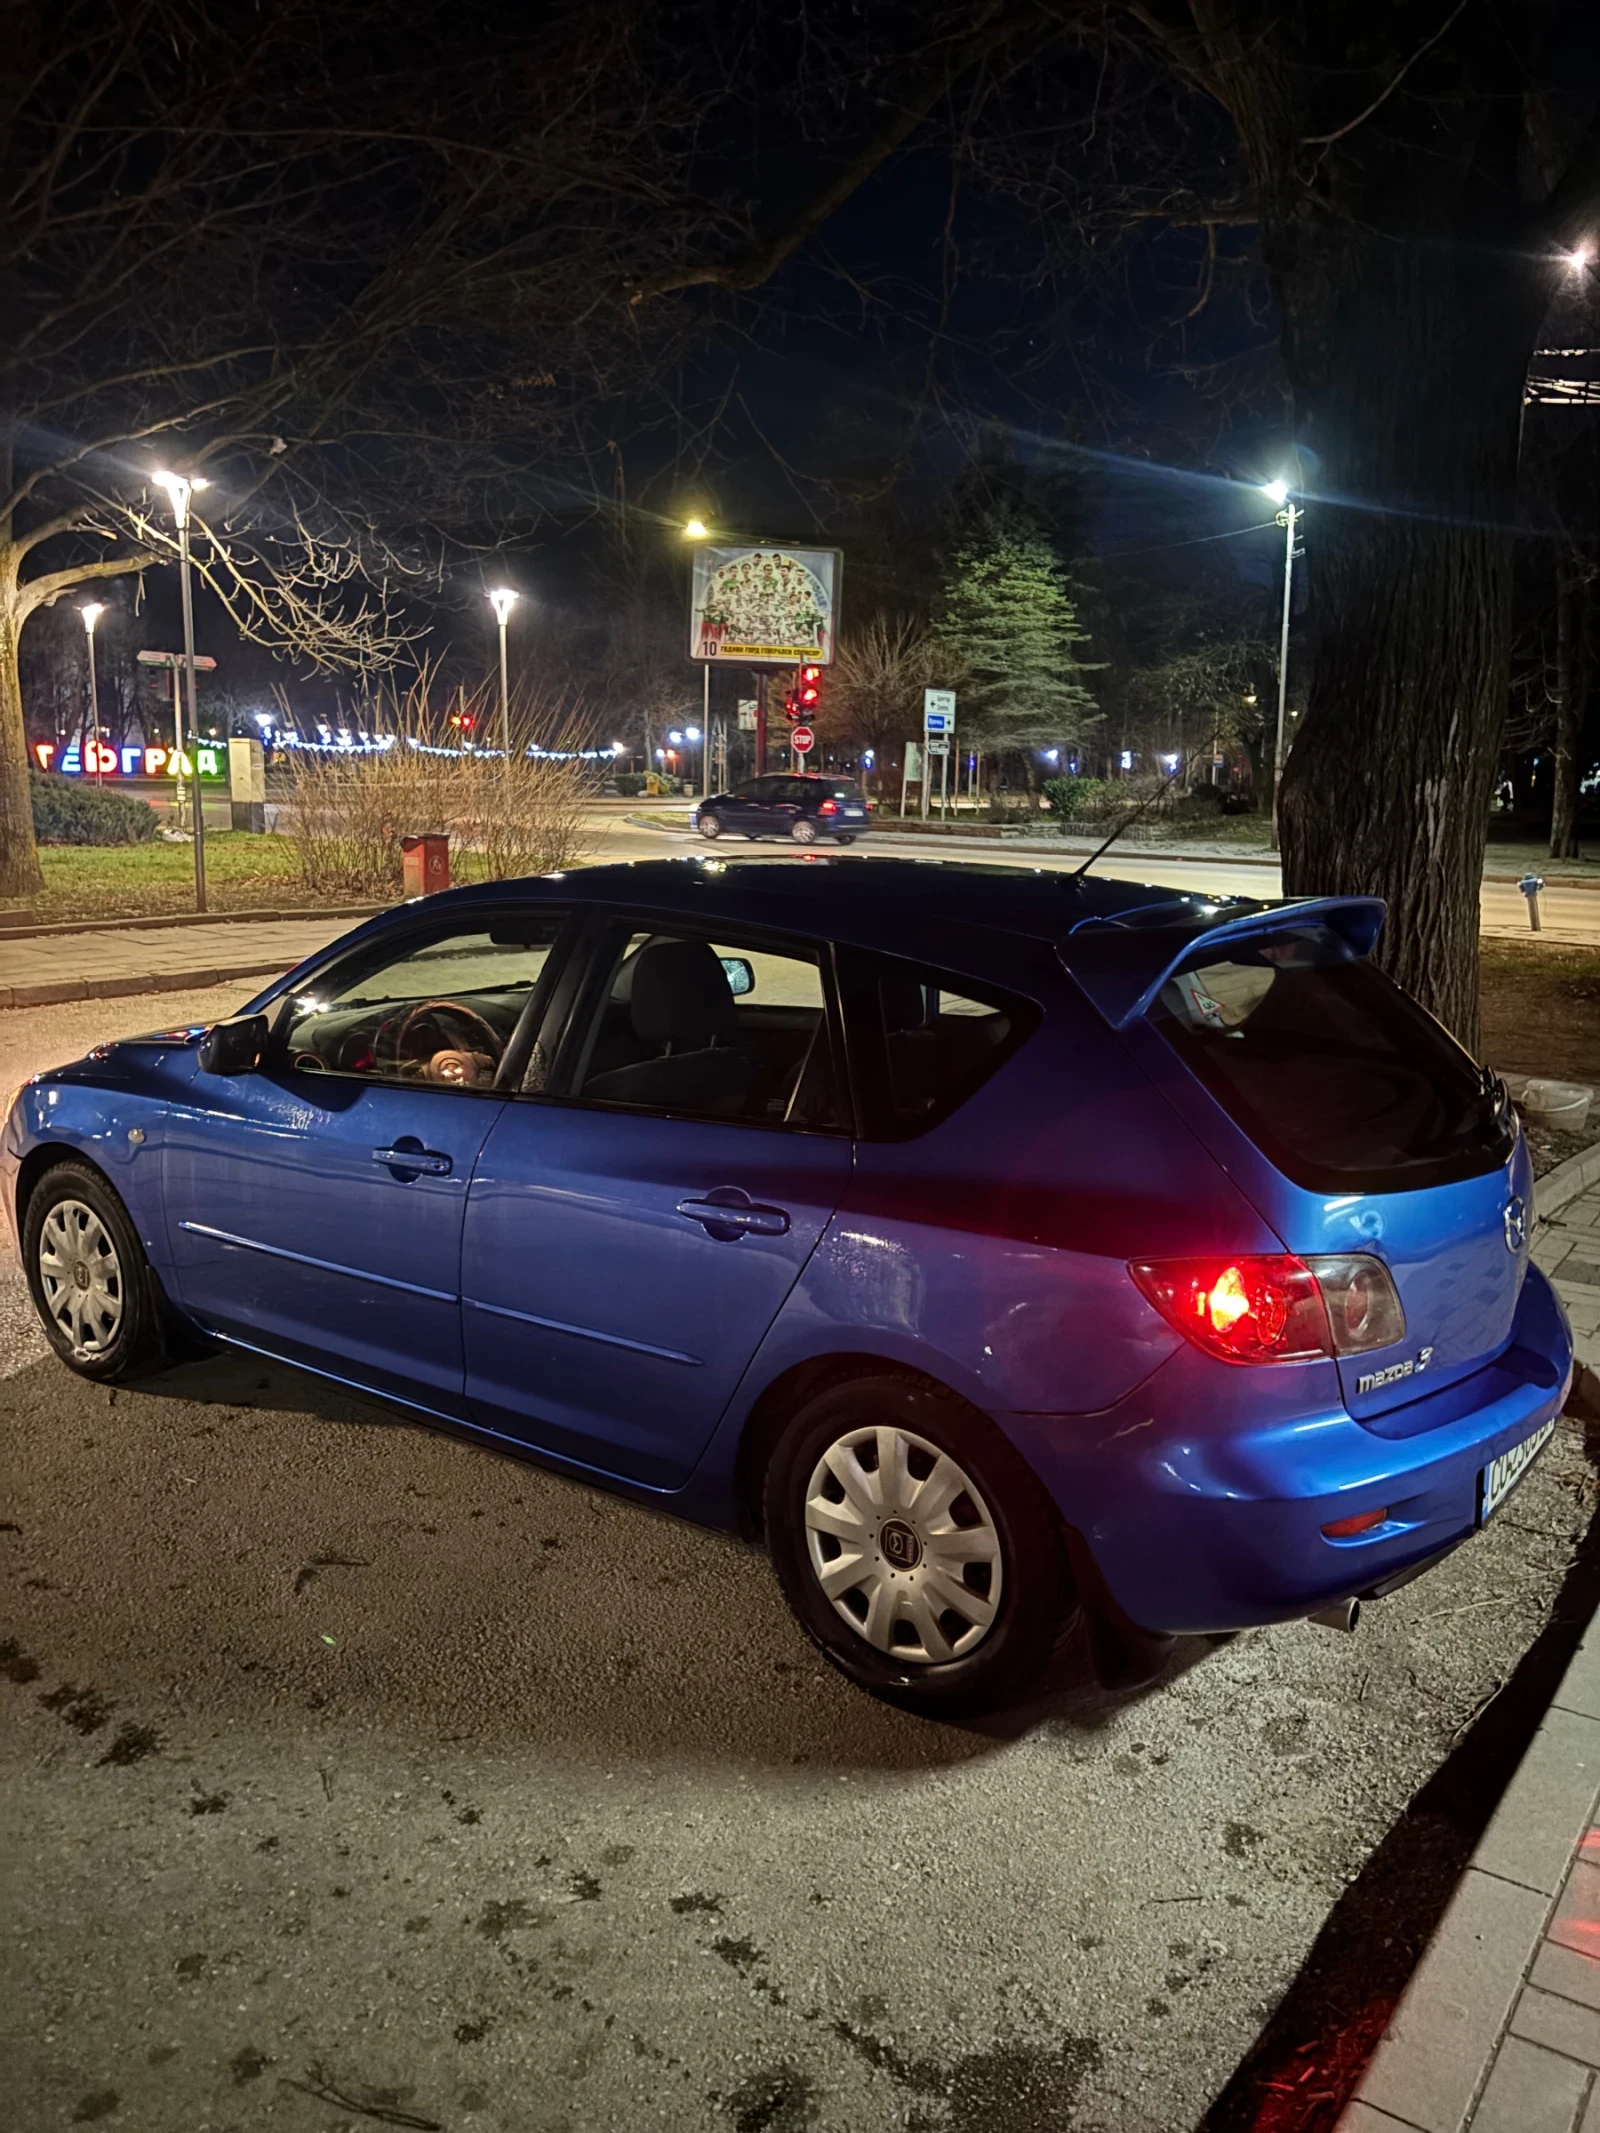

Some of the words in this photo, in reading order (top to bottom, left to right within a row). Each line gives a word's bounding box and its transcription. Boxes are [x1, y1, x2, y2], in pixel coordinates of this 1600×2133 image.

[703, 641, 717, 656] 10
[794, 735, 811, 744] STOP
[1415, 1346, 1433, 1373] 3
